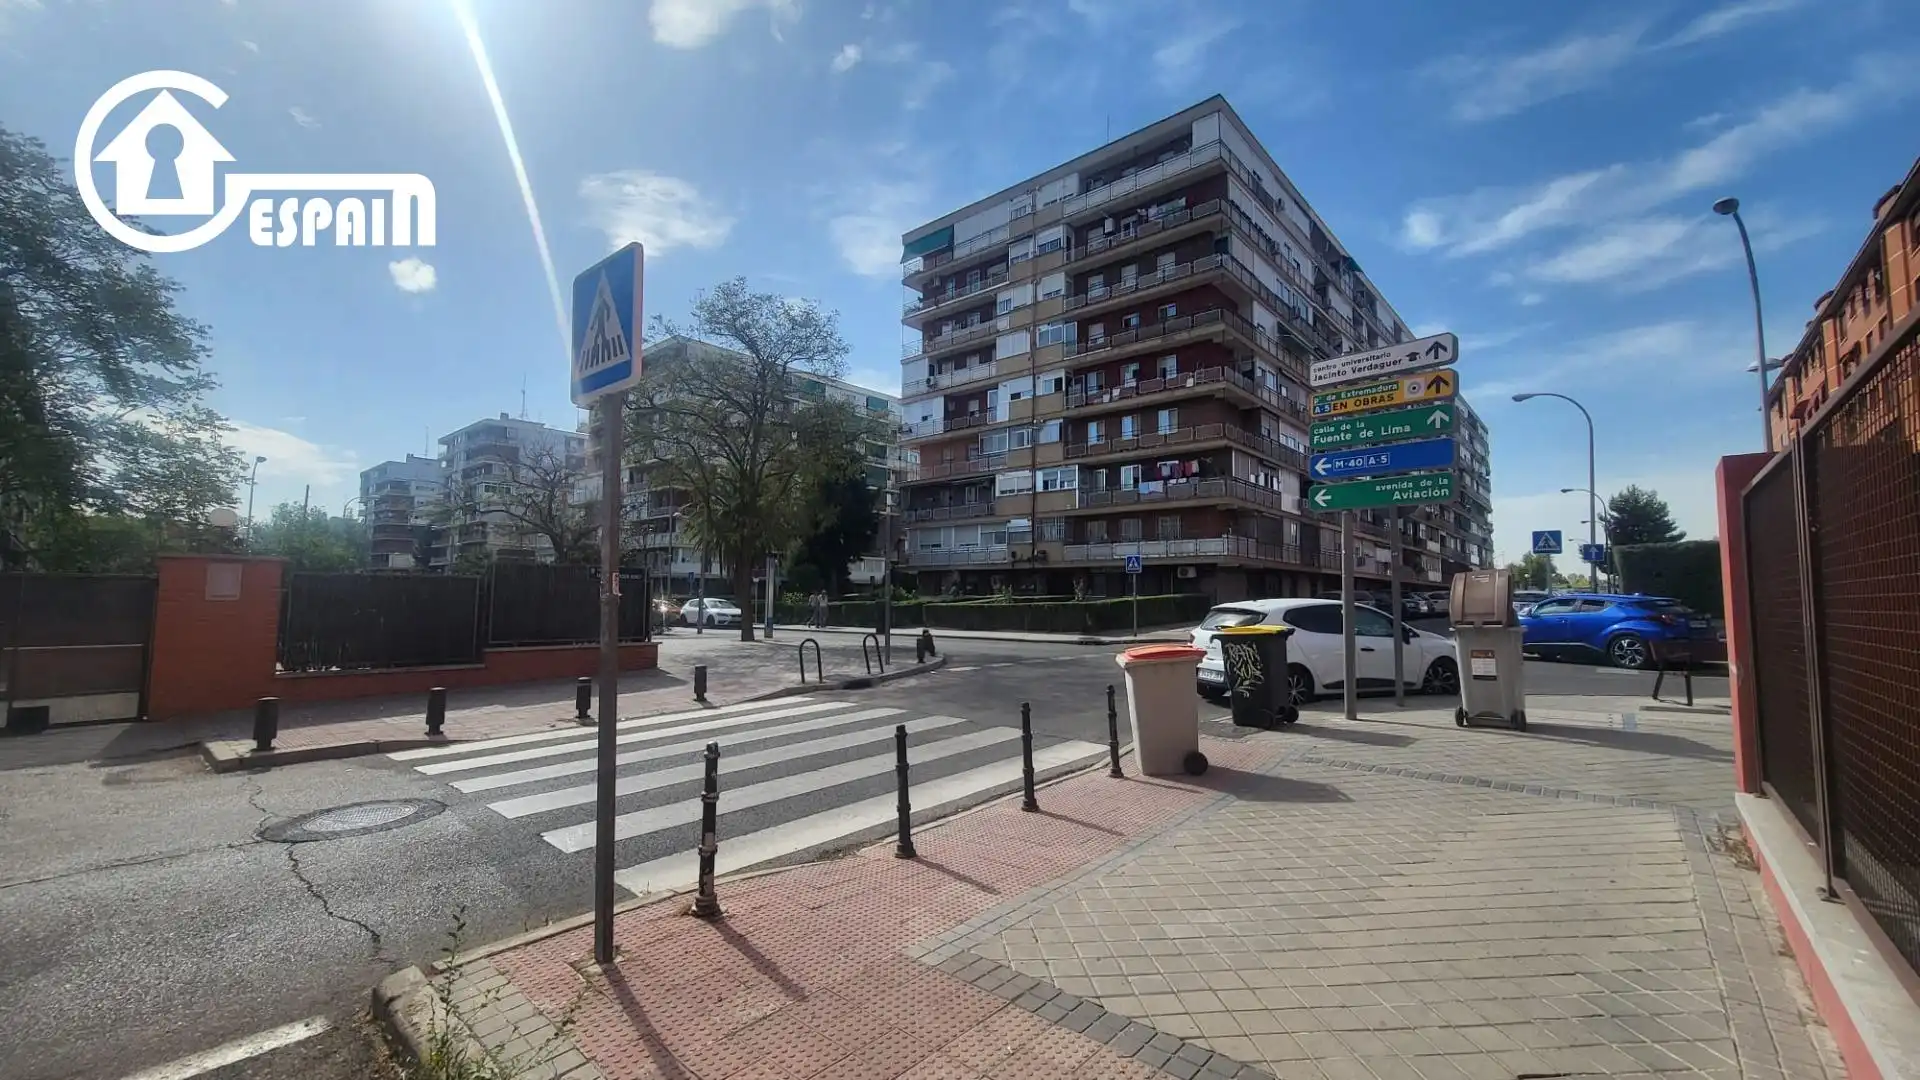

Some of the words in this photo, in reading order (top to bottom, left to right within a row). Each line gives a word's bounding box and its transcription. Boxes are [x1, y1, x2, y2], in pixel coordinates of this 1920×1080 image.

[1313, 364, 1337, 373] centro
[1341, 352, 1391, 367] universitario
[1313, 370, 1347, 381] Jacinto
[1351, 359, 1402, 374] Verdaguer
[1341, 384, 1397, 398] Extremadura
[1333, 402, 1348, 411] EN
[1354, 394, 1394, 407] OBRAS
[1313, 433, 1352, 444] Fuente
[1359, 430, 1374, 439] de
[1381, 425, 1411, 434] Lima
[1314, 425, 1335, 434] calle
[1356, 420, 1365, 429] la
[1376, 481, 1413, 492] avenida
[1420, 478, 1433, 487] de
[1439, 477, 1448, 485] la
[1393, 488, 1449, 500] Aviación
